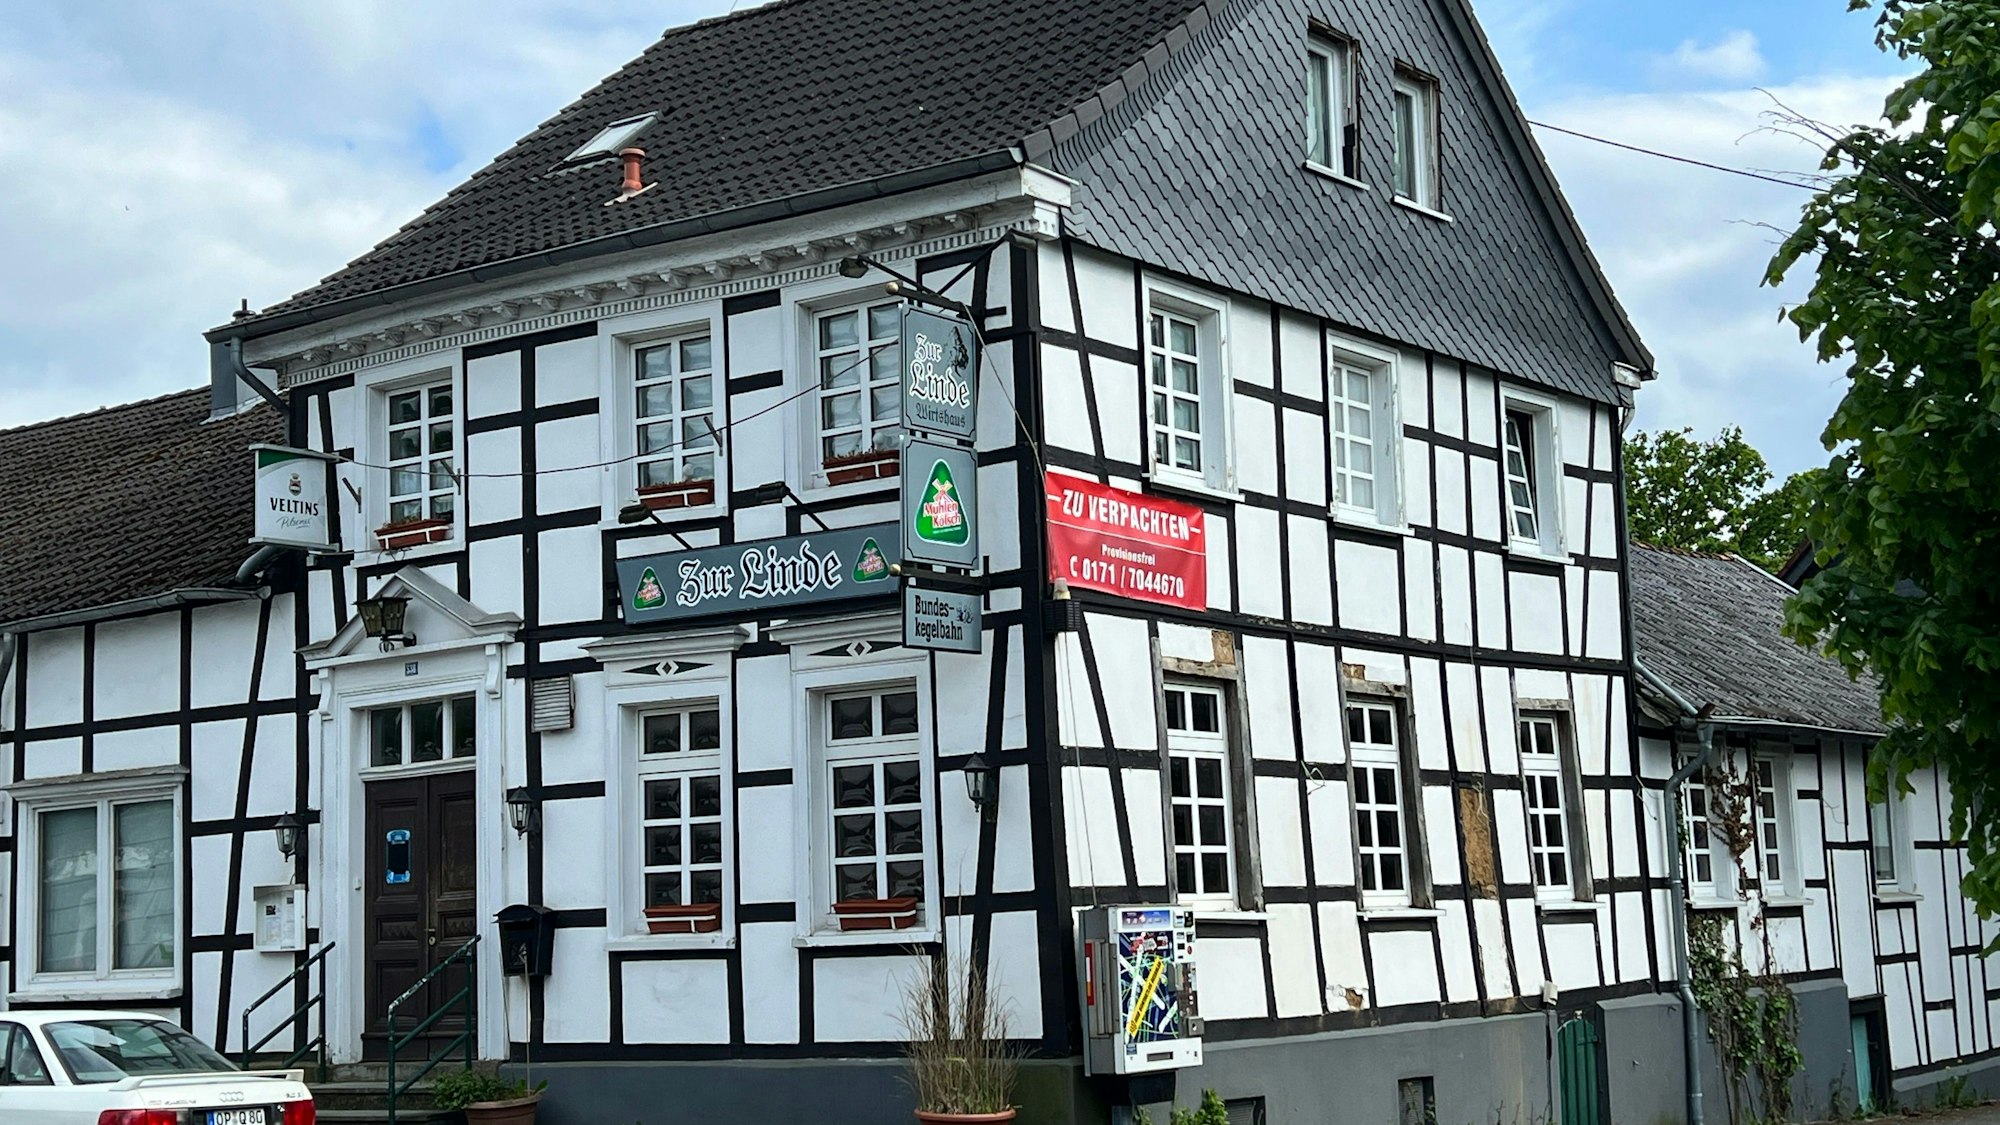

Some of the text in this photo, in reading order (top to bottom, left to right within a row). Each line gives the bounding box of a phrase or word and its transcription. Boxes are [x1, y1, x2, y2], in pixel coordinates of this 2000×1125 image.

[914, 332, 942, 363] Zur
[909, 359, 970, 409] Linde
[915, 402, 966, 428] Wirtshaus
[270, 497, 319, 517] VELTINS
[1062, 489, 1190, 541] ZU VERPACHTEN
[1101, 543, 1156, 566] Provisionsfrei
[676, 539, 843, 607] Zur Linde
[1082, 558, 1116, 586] 0171
[1128, 567, 1185, 599] 7044670
[914, 594, 955, 618] Bundes-
[914, 616, 963, 643] kegelbahn
